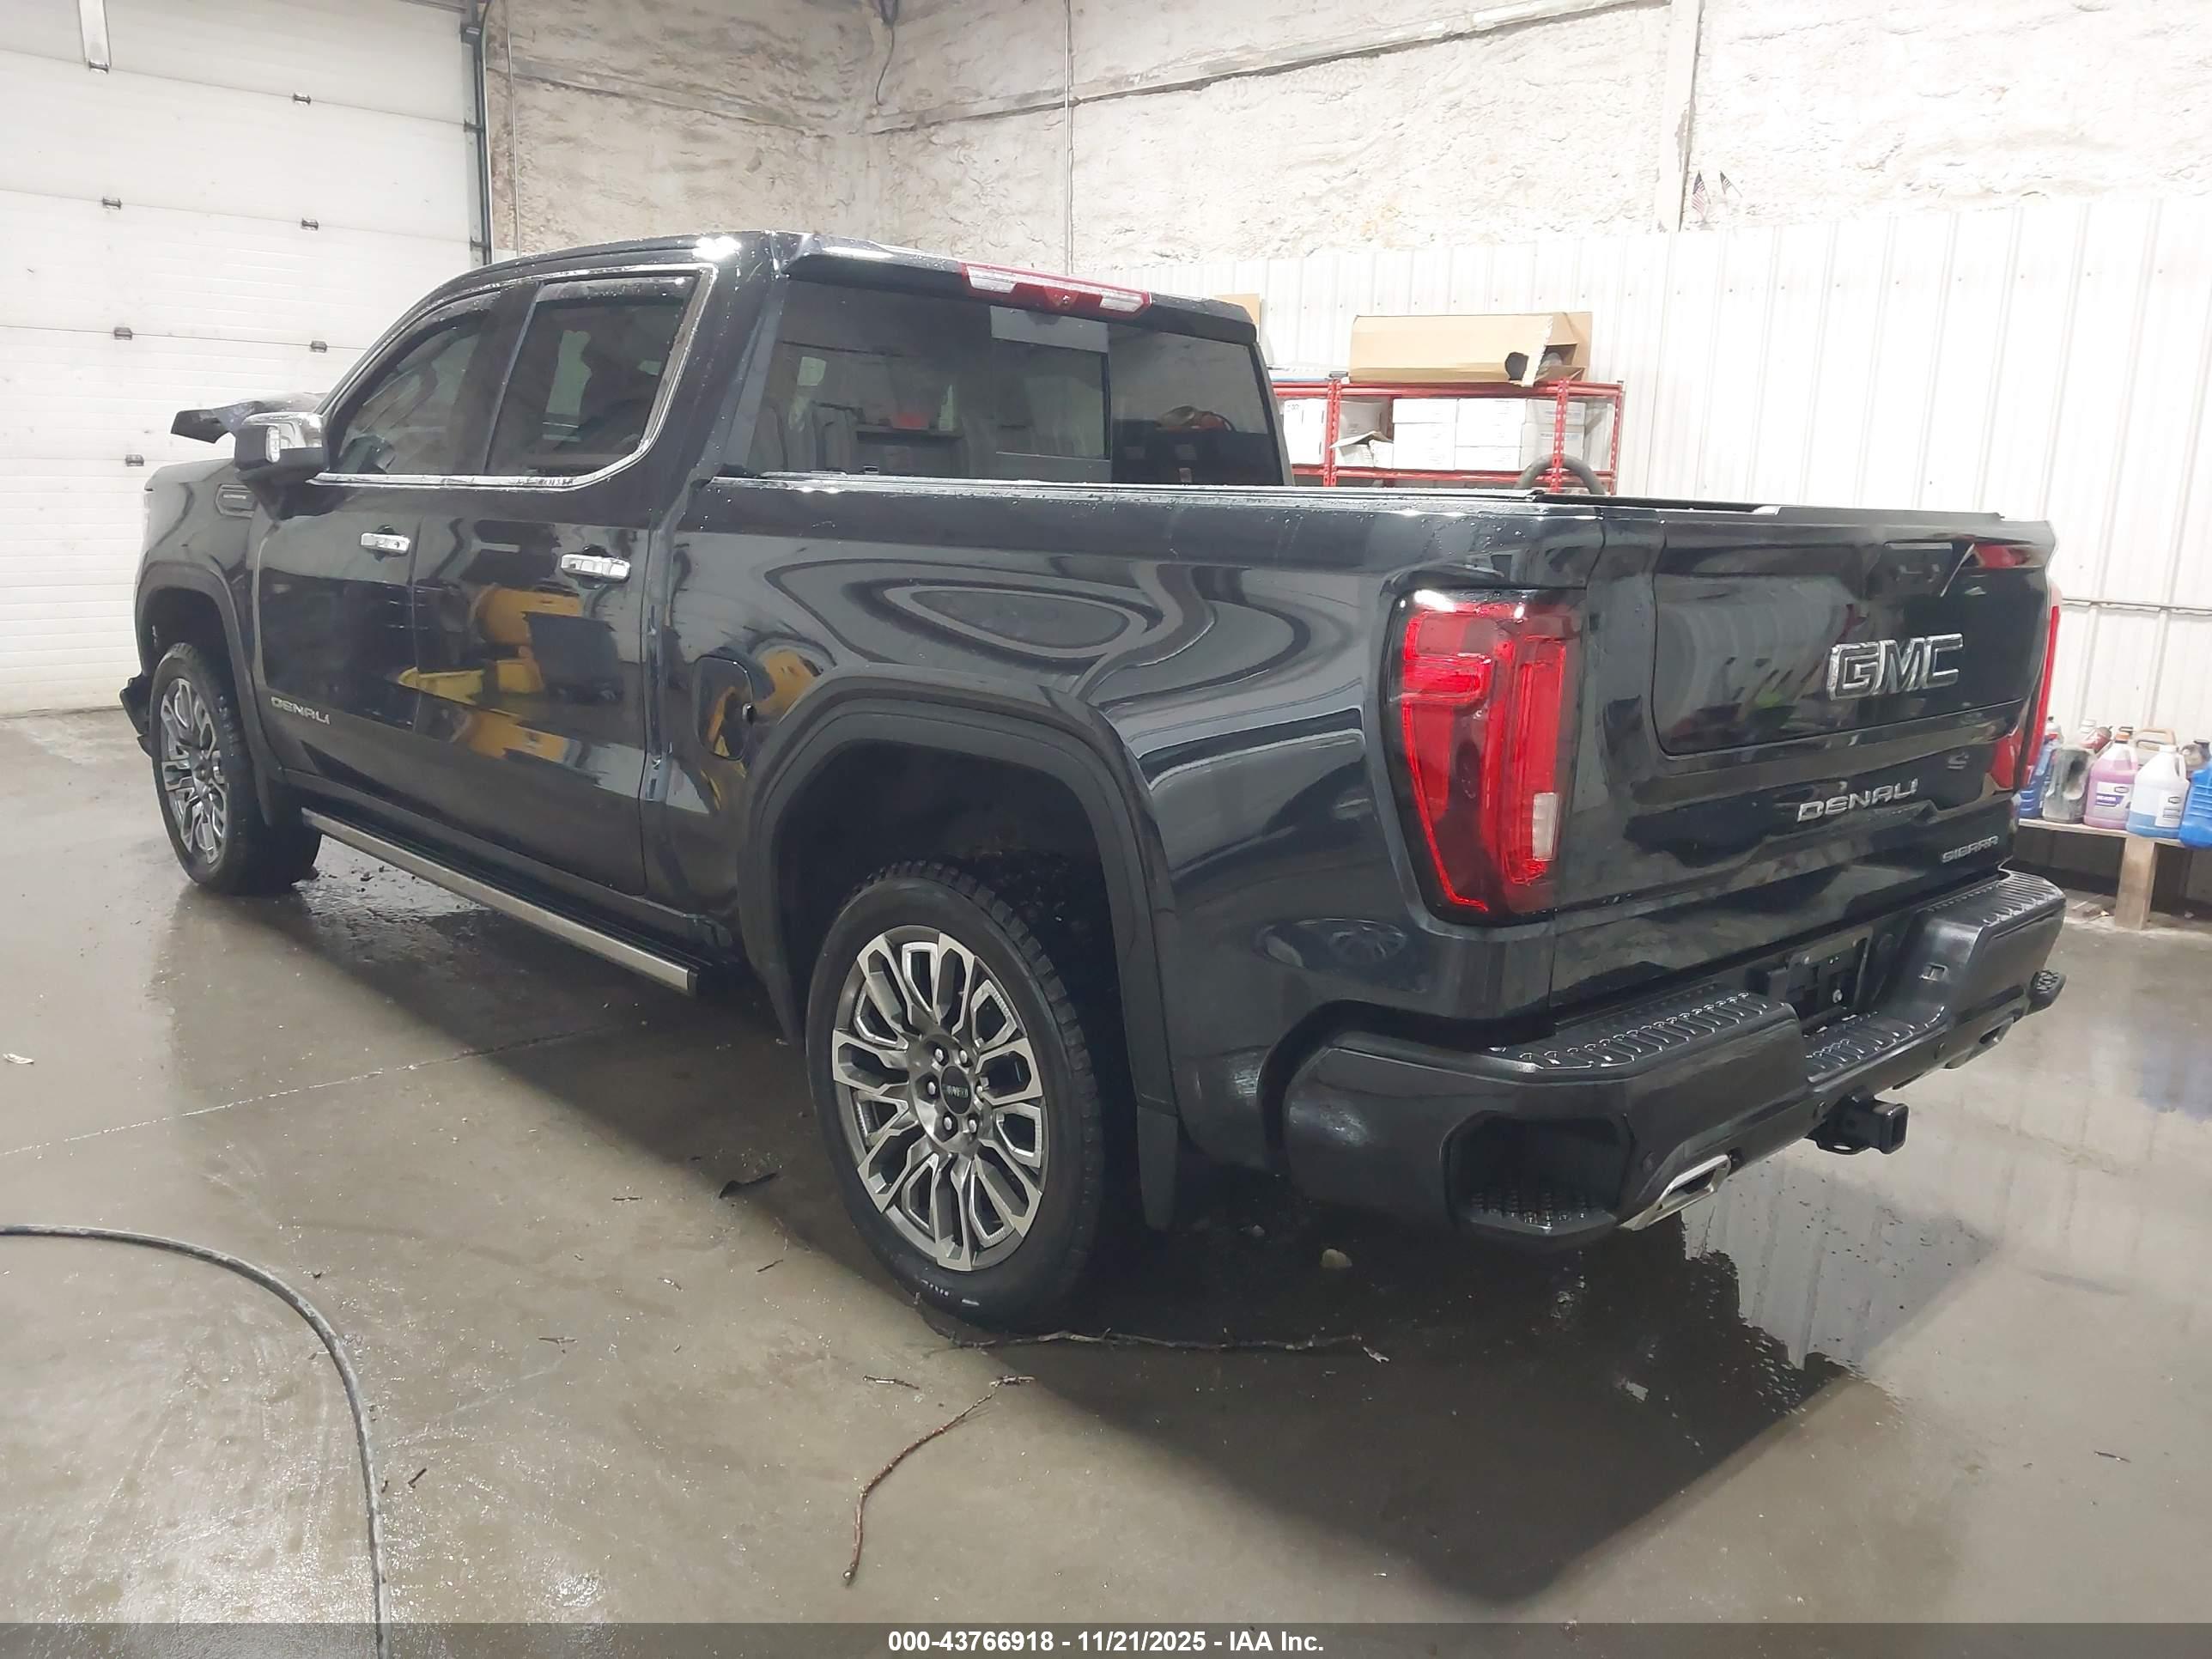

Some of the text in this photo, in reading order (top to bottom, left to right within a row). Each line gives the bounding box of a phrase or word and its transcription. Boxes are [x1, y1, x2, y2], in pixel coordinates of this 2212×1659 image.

[1827, 633, 1964, 701] GMC
[270, 696, 331, 725] DENALI
[1797, 778, 1919, 823] DENALI
[1942, 836, 1999, 863] SIERRA
